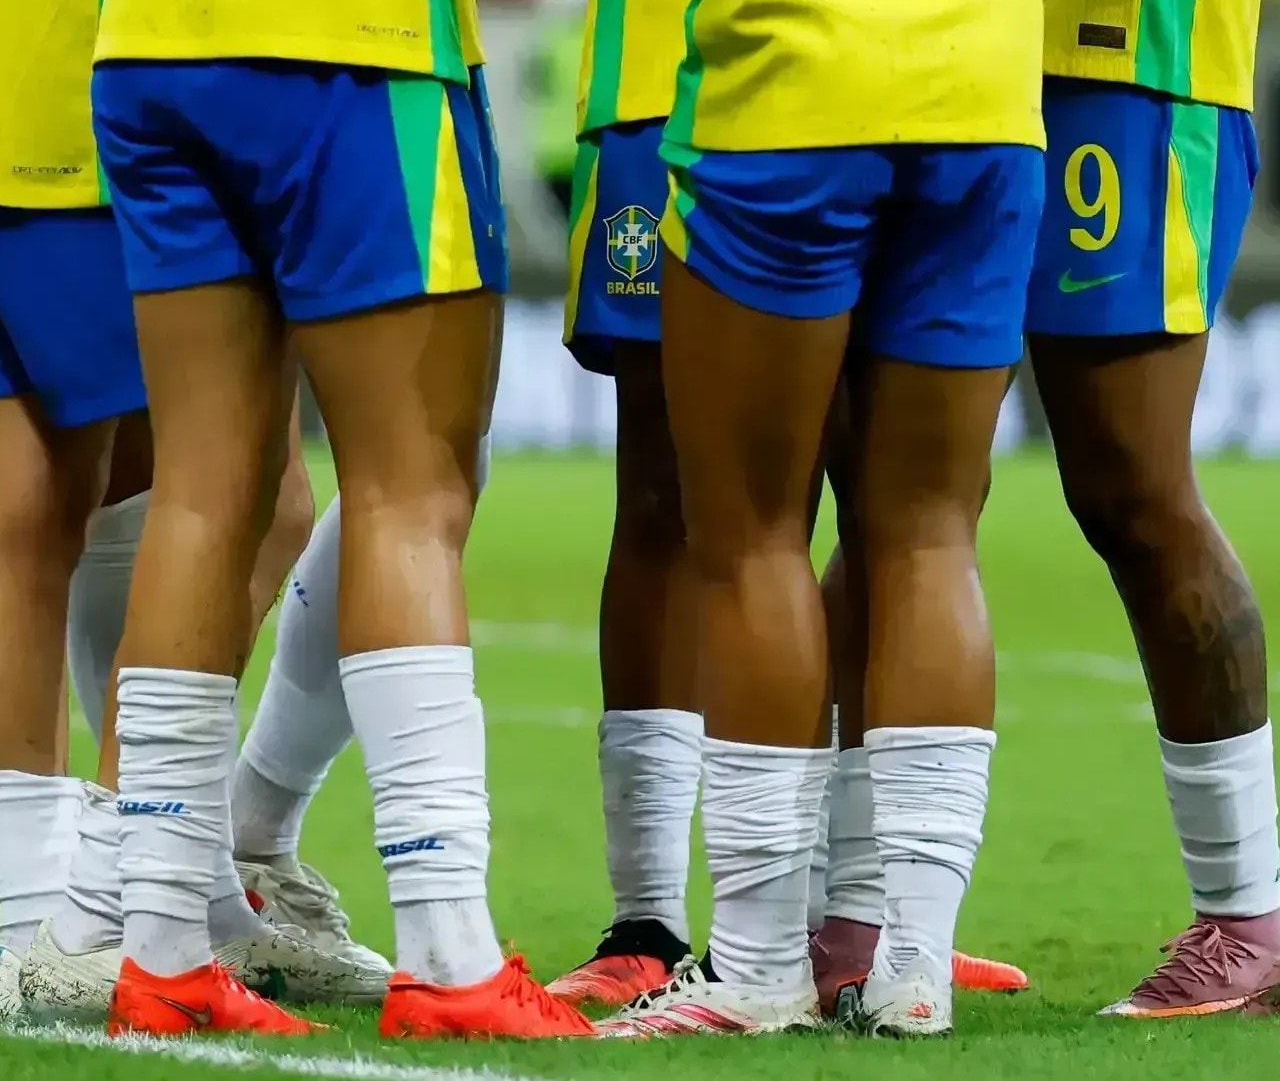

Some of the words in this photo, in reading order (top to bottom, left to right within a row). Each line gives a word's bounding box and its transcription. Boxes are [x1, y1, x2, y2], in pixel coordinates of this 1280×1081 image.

[1064, 143, 1121, 252] 9
[623, 235, 643, 245] CBF
[606, 281, 660, 295] BRASIL
[117, 801, 191, 815] ASIL
